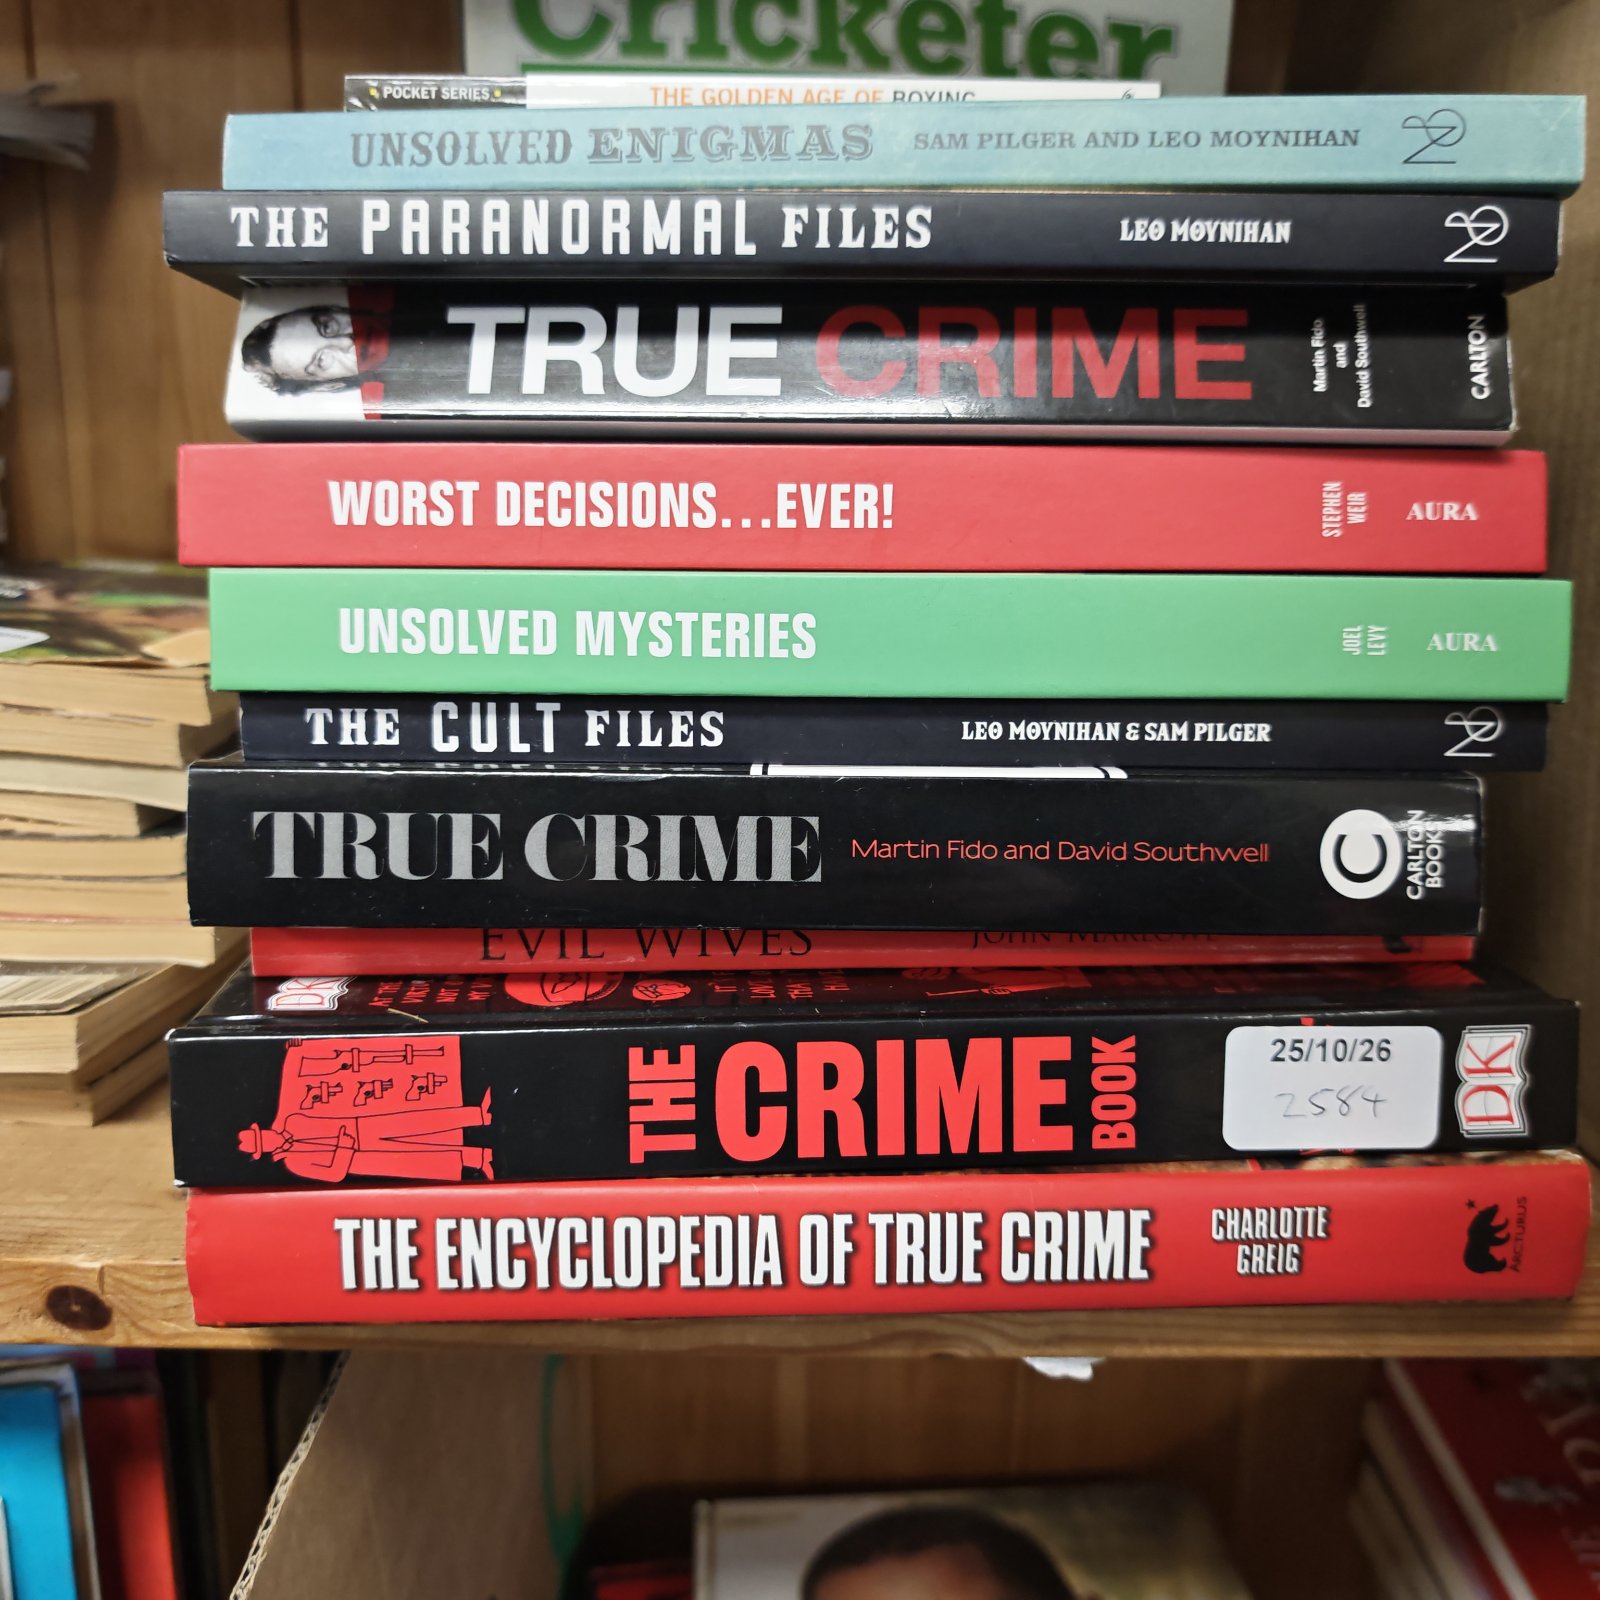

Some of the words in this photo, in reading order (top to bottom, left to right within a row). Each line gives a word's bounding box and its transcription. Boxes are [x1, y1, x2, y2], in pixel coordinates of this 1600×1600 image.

[510, 0, 1174, 80] Cricketer
[383, 86, 438, 100] POCKET
[441, 87, 490, 100] SERIES
[650, 87, 693, 106] THE
[701, 87, 793, 106] GOLDEN
[803, 88, 844, 105] AGE
[854, 89, 884, 104] OF
[350, 128, 573, 168] UNSOLVED
[587, 124, 874, 164] ENIGMAS
[913, 130, 970, 150] SAM
[977, 130, 1076, 150] PILGER
[1084, 130, 1140, 149] AND
[1149, 129, 1201, 148] LEO
[1210, 128, 1361, 148] MOYNIHAN
[231, 206, 329, 248] THE
[362, 198, 757, 256] PARANORMAL
[781, 204, 933, 250] FILES
[1120, 219, 1165, 242] LEO
[1170, 218, 1291, 244] MOYNIHAN
[1311, 317, 1326, 348] Fido
[1353, 304, 1371, 369] Southwell
[447, 305, 783, 397] TRUE
[815, 306, 1253, 401] CRIME
[1312, 348, 1328, 392] Martin
[1333, 341, 1349, 368] and
[1467, 314, 1491, 400] CARLTON
[1356, 370, 1373, 408] David
[328, 480, 480, 527] WORST
[1321, 481, 1343, 537] STEPHEN
[1346, 491, 1368, 524] WEIR
[1406, 501, 1479, 521] AURA
[339, 608, 558, 656] UNSOLVED
[576, 611, 818, 659] MYSTERIES
[1342, 625, 1362, 655] JOEL
[1367, 625, 1387, 656] LEVY
[1426, 632, 1498, 652] AURA
[305, 708, 400, 746] THE
[431, 701, 562, 754] CULT
[585, 710, 725, 748] FILES
[961, 721, 1003, 741] LEO
[1008, 720, 1123, 742] MOYNIHAN
[1126, 722, 1140, 741] &
[1144, 722, 1189, 742] SAM
[1193, 722, 1271, 743] PILGER
[252, 811, 503, 882] TRUE
[524, 813, 822, 883] CRIME
[851, 839, 940, 860] Martin
[947, 839, 998, 861] Fido
[1004, 839, 1050, 861] and
[1058, 840, 1127, 861] David
[1133, 841, 1269, 863] Southwell
[1406, 810, 1426, 900] CARLTON
[1426, 820, 1445, 888] BOOK
[480, 928, 605, 961] EVIL
[636, 928, 813, 958] WIVES
[1270, 1037, 1392, 1063] 25/10/26
[629, 1044, 697, 1164] THE
[715, 1036, 1074, 1163] CRIME
[1091, 1034, 1137, 1150] BOOK
[1462, 1035, 1518, 1125] DK
[1274, 1084, 1388, 1118] 2584
[1210, 1206, 1330, 1241] CHARLOTTE
[1509, 1196, 1527, 1273] ARCTURUS
[334, 1217, 420, 1292] THE
[435, 1213, 784, 1290] ENCYCLOPEDIA
[799, 1213, 854, 1287] OF
[868, 1210, 984, 1286] TRUE
[1000, 1208, 1152, 1284] CRIME
[1236, 1243, 1302, 1276] GREIG
